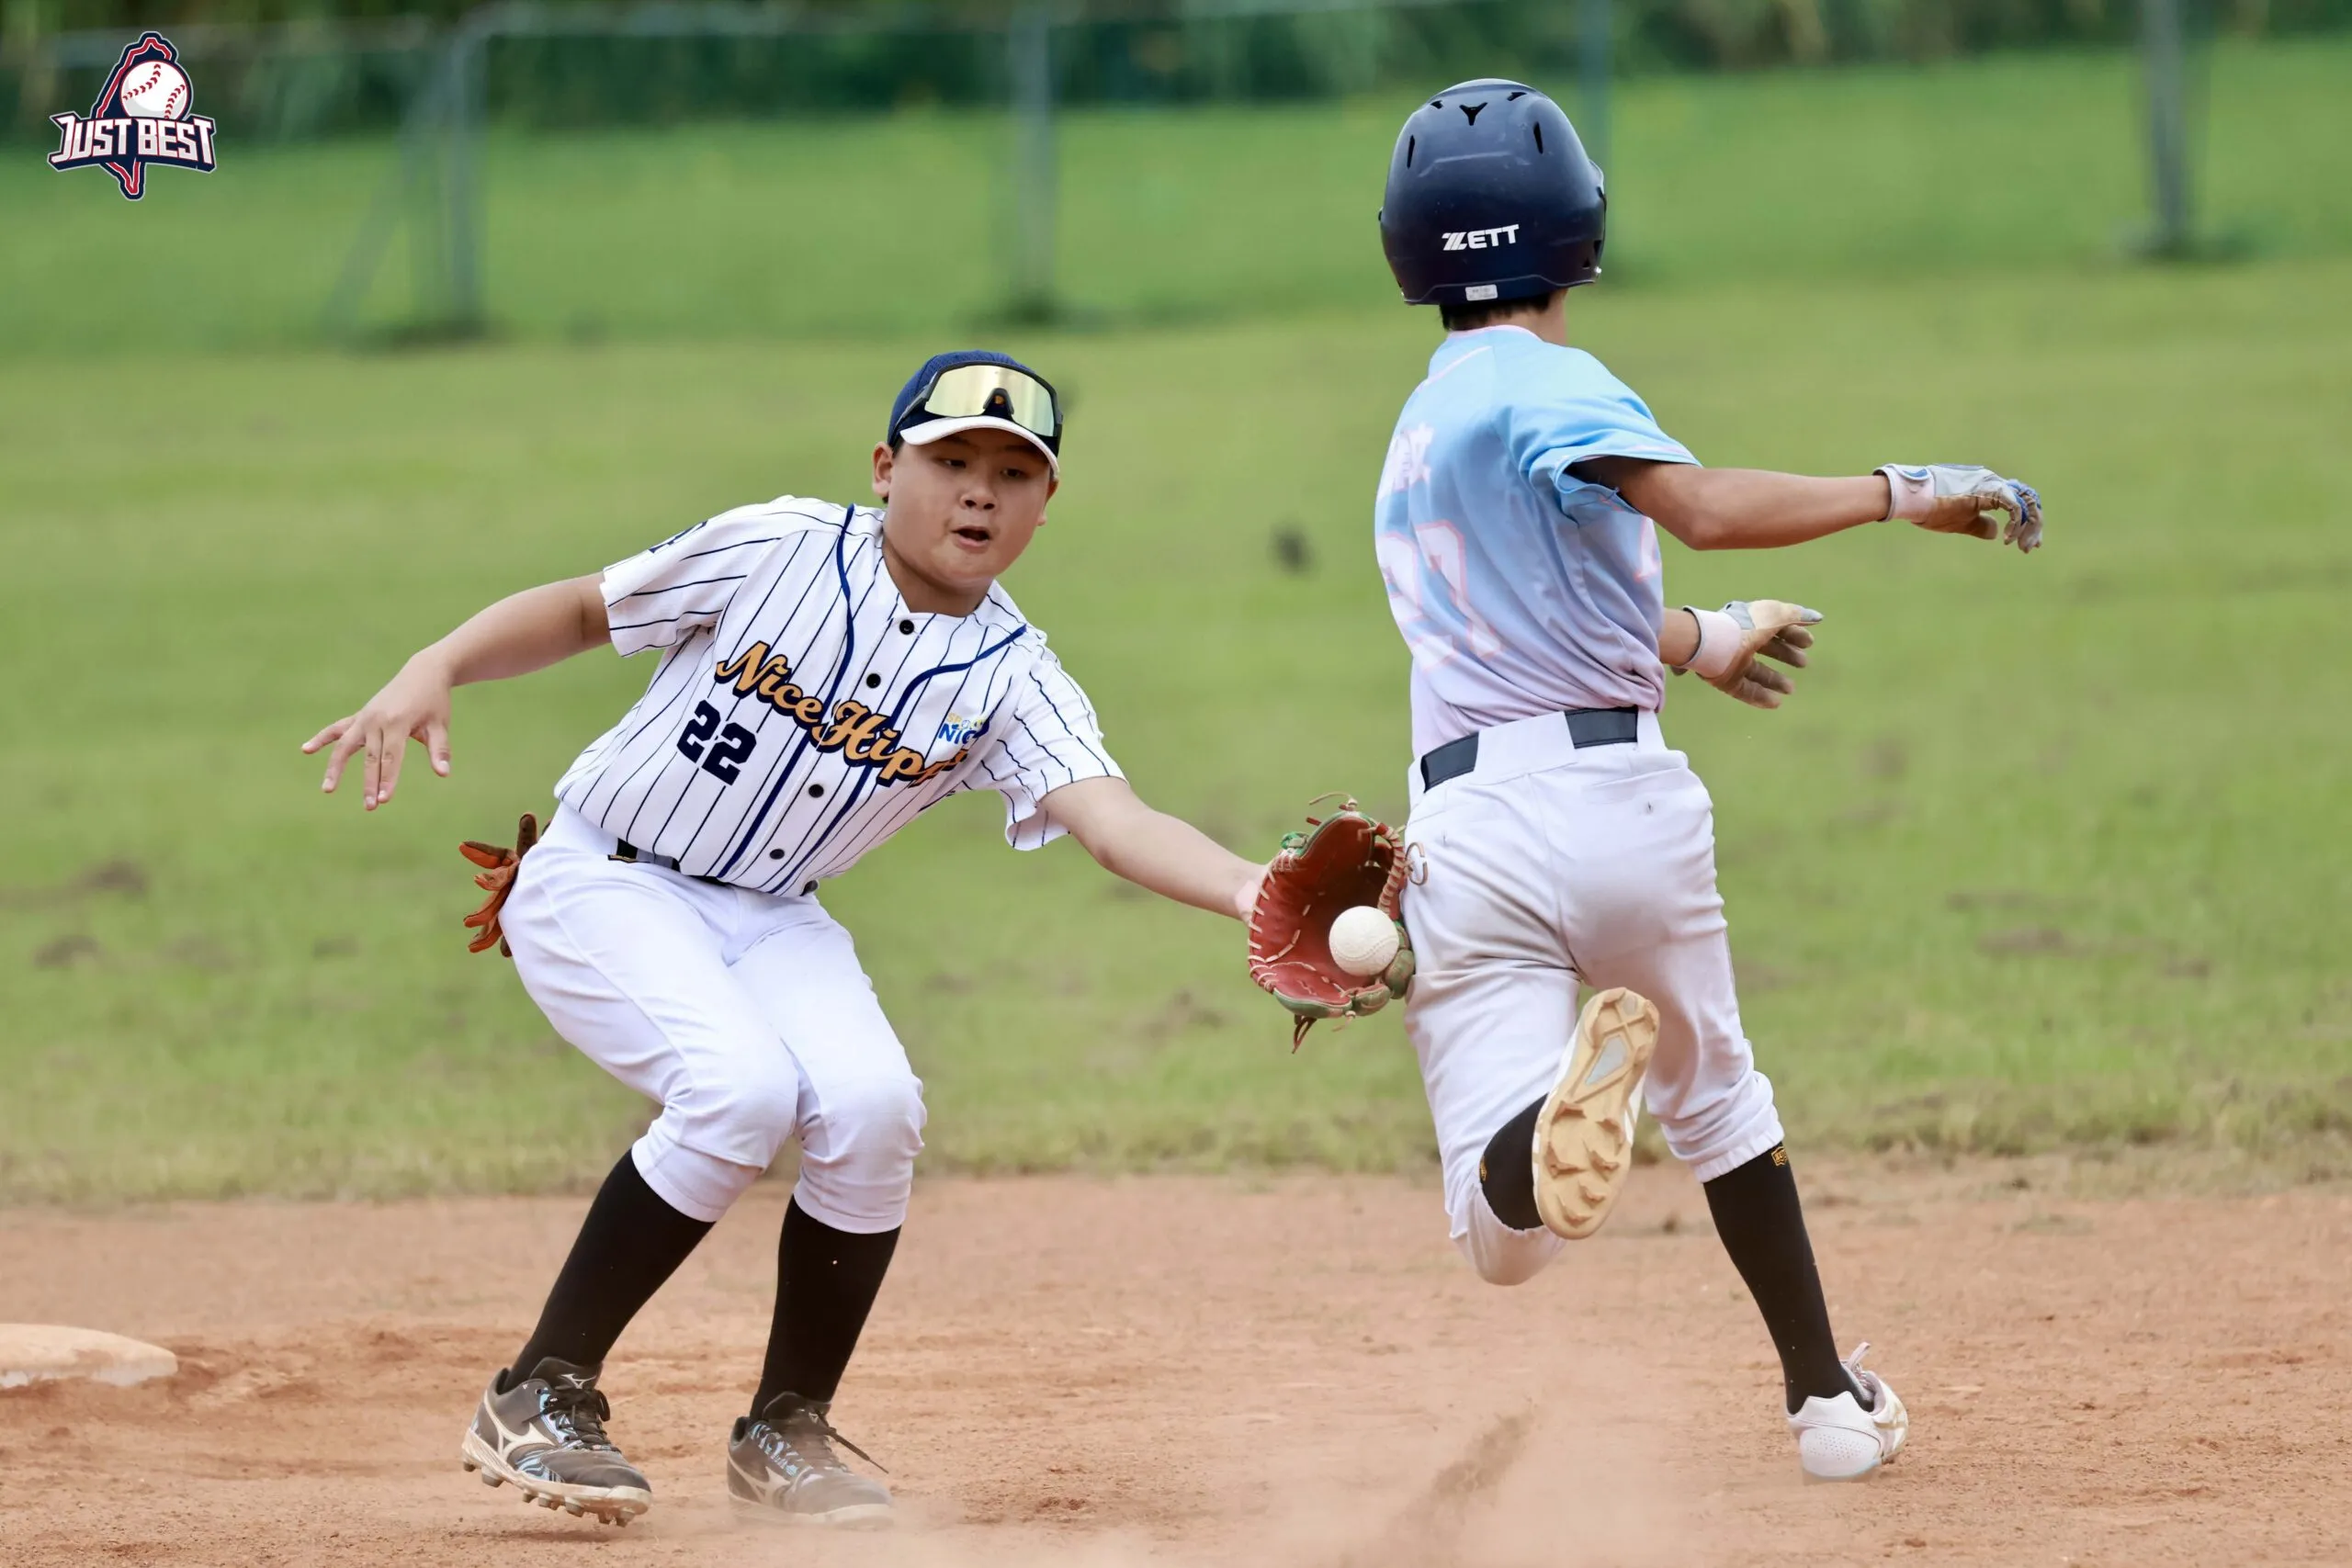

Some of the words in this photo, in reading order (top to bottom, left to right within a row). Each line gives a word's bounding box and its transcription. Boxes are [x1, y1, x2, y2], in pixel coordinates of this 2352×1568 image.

[1442, 224, 1520, 252] ZETT
[714, 640, 825, 730] Nice
[676, 699, 757, 786] 22
